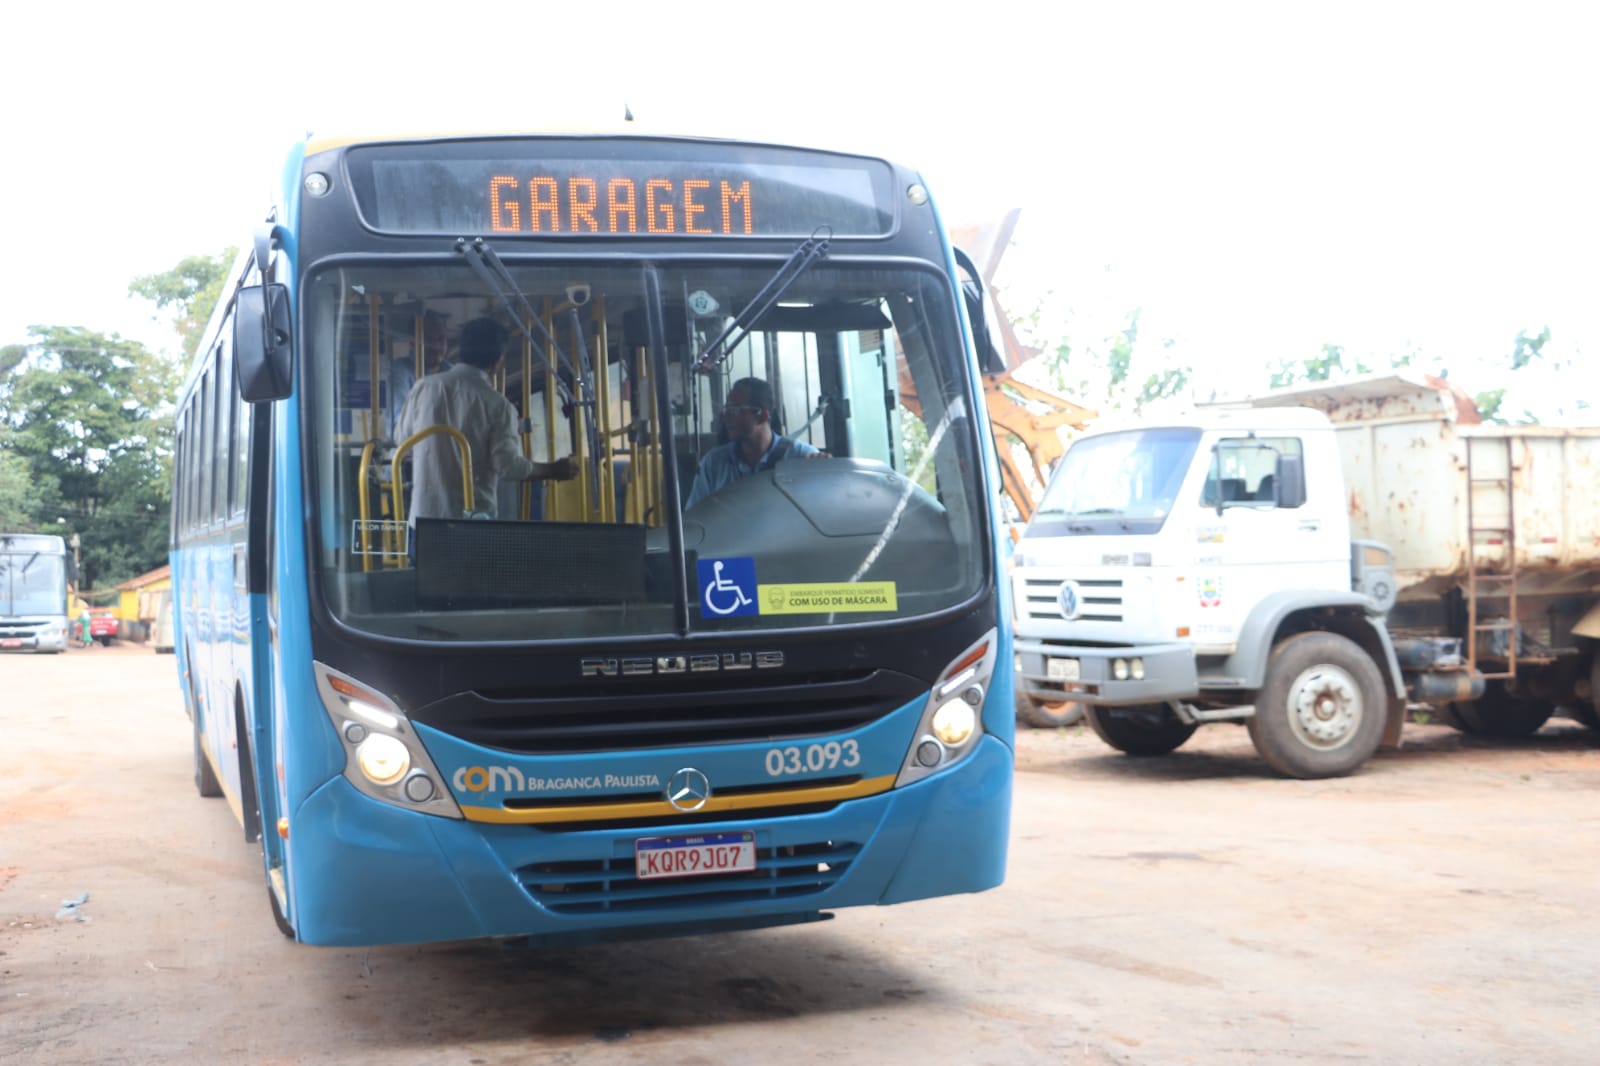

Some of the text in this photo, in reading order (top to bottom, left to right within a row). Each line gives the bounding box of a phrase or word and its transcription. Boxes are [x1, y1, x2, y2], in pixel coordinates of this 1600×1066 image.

[490, 176, 752, 234] GARAGEM
[789, 598, 810, 606] COM
[811, 597, 831, 606] USO
[832, 597, 843, 605] DE
[581, 651, 784, 676] NEOBUS
[765, 739, 861, 776] 03.093
[528, 776, 602, 791] BRAGANÇA
[604, 774, 660, 787] PAULISTA
